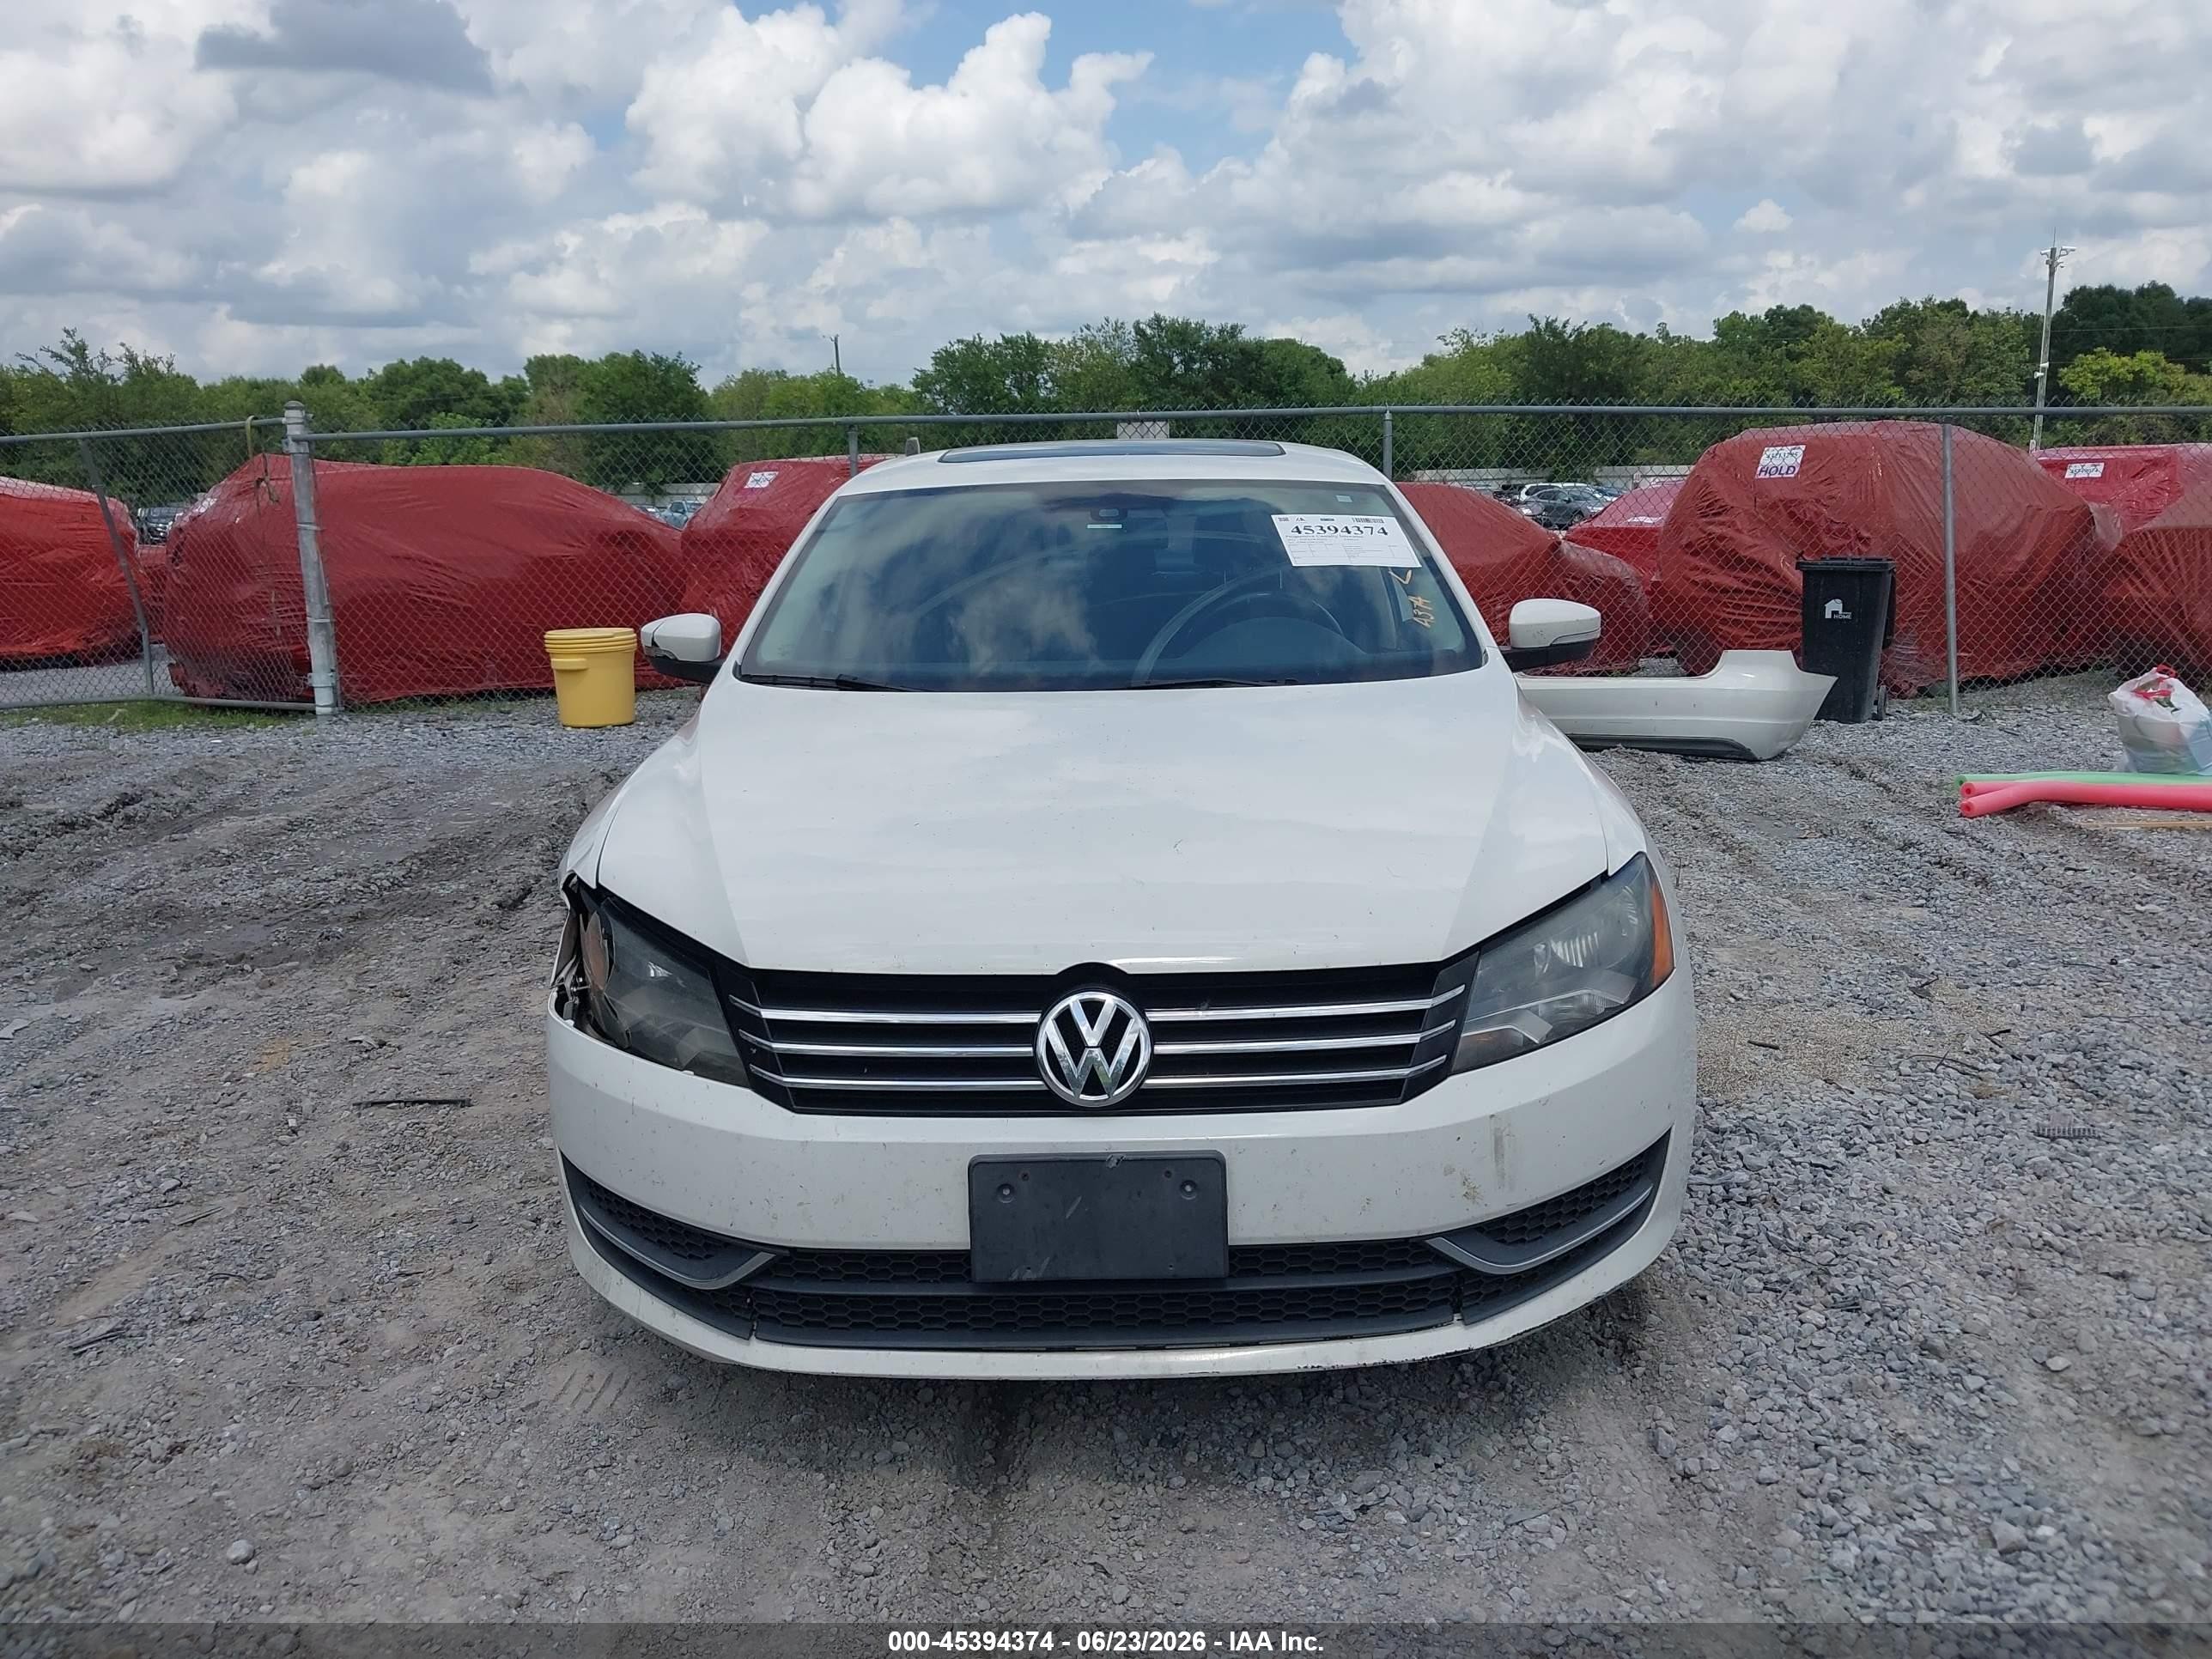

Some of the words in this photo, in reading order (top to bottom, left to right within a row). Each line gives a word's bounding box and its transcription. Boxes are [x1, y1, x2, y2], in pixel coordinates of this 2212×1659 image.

[1759, 465, 1796, 477] HOLD
[1291, 525, 1389, 537] 45394374
[1039, 994, 1148, 1103] VW
